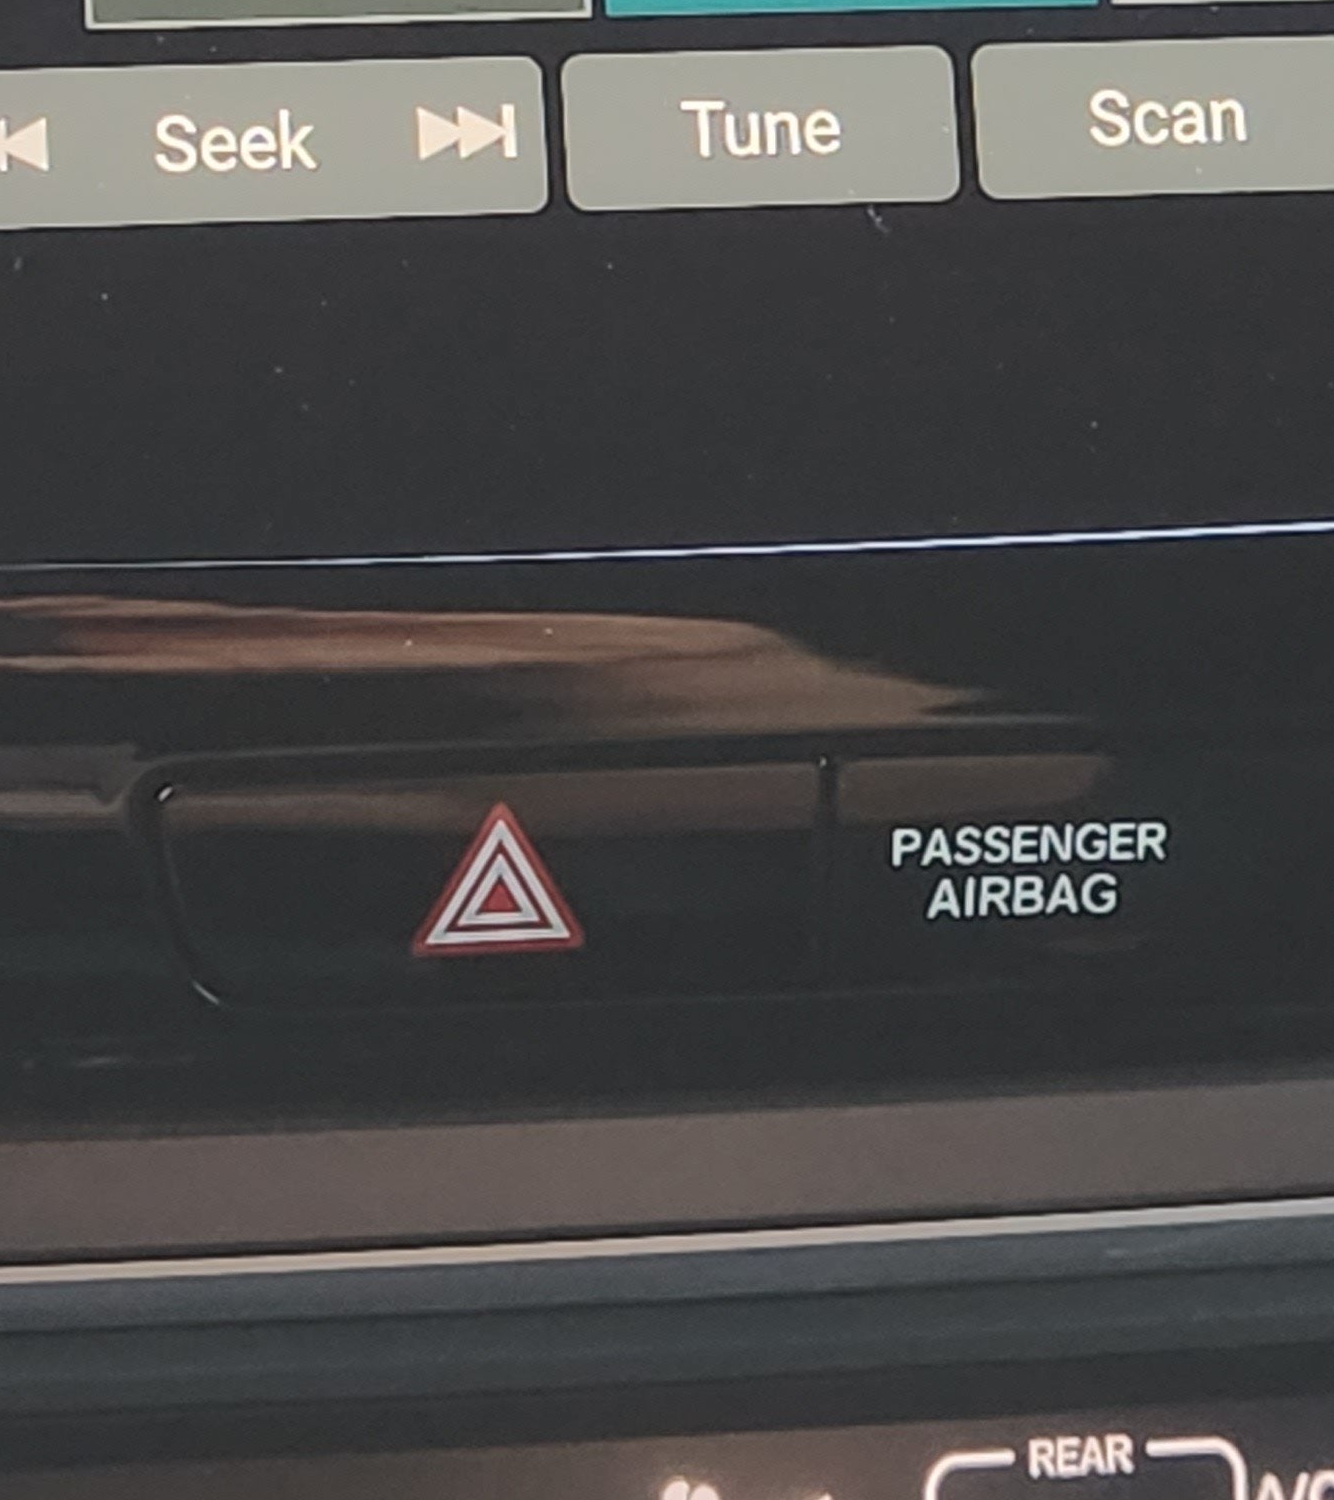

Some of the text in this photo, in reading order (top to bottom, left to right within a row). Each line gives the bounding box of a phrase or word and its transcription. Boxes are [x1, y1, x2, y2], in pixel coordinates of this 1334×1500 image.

[155, 110, 318, 172] Seek
[681, 100, 841, 158] Tune
[1089, 91, 1249, 147] Scan
[891, 822, 1167, 867] PASSENGER
[927, 873, 1117, 919] AIRBAG
[1028, 1434, 1135, 1478] REAR
